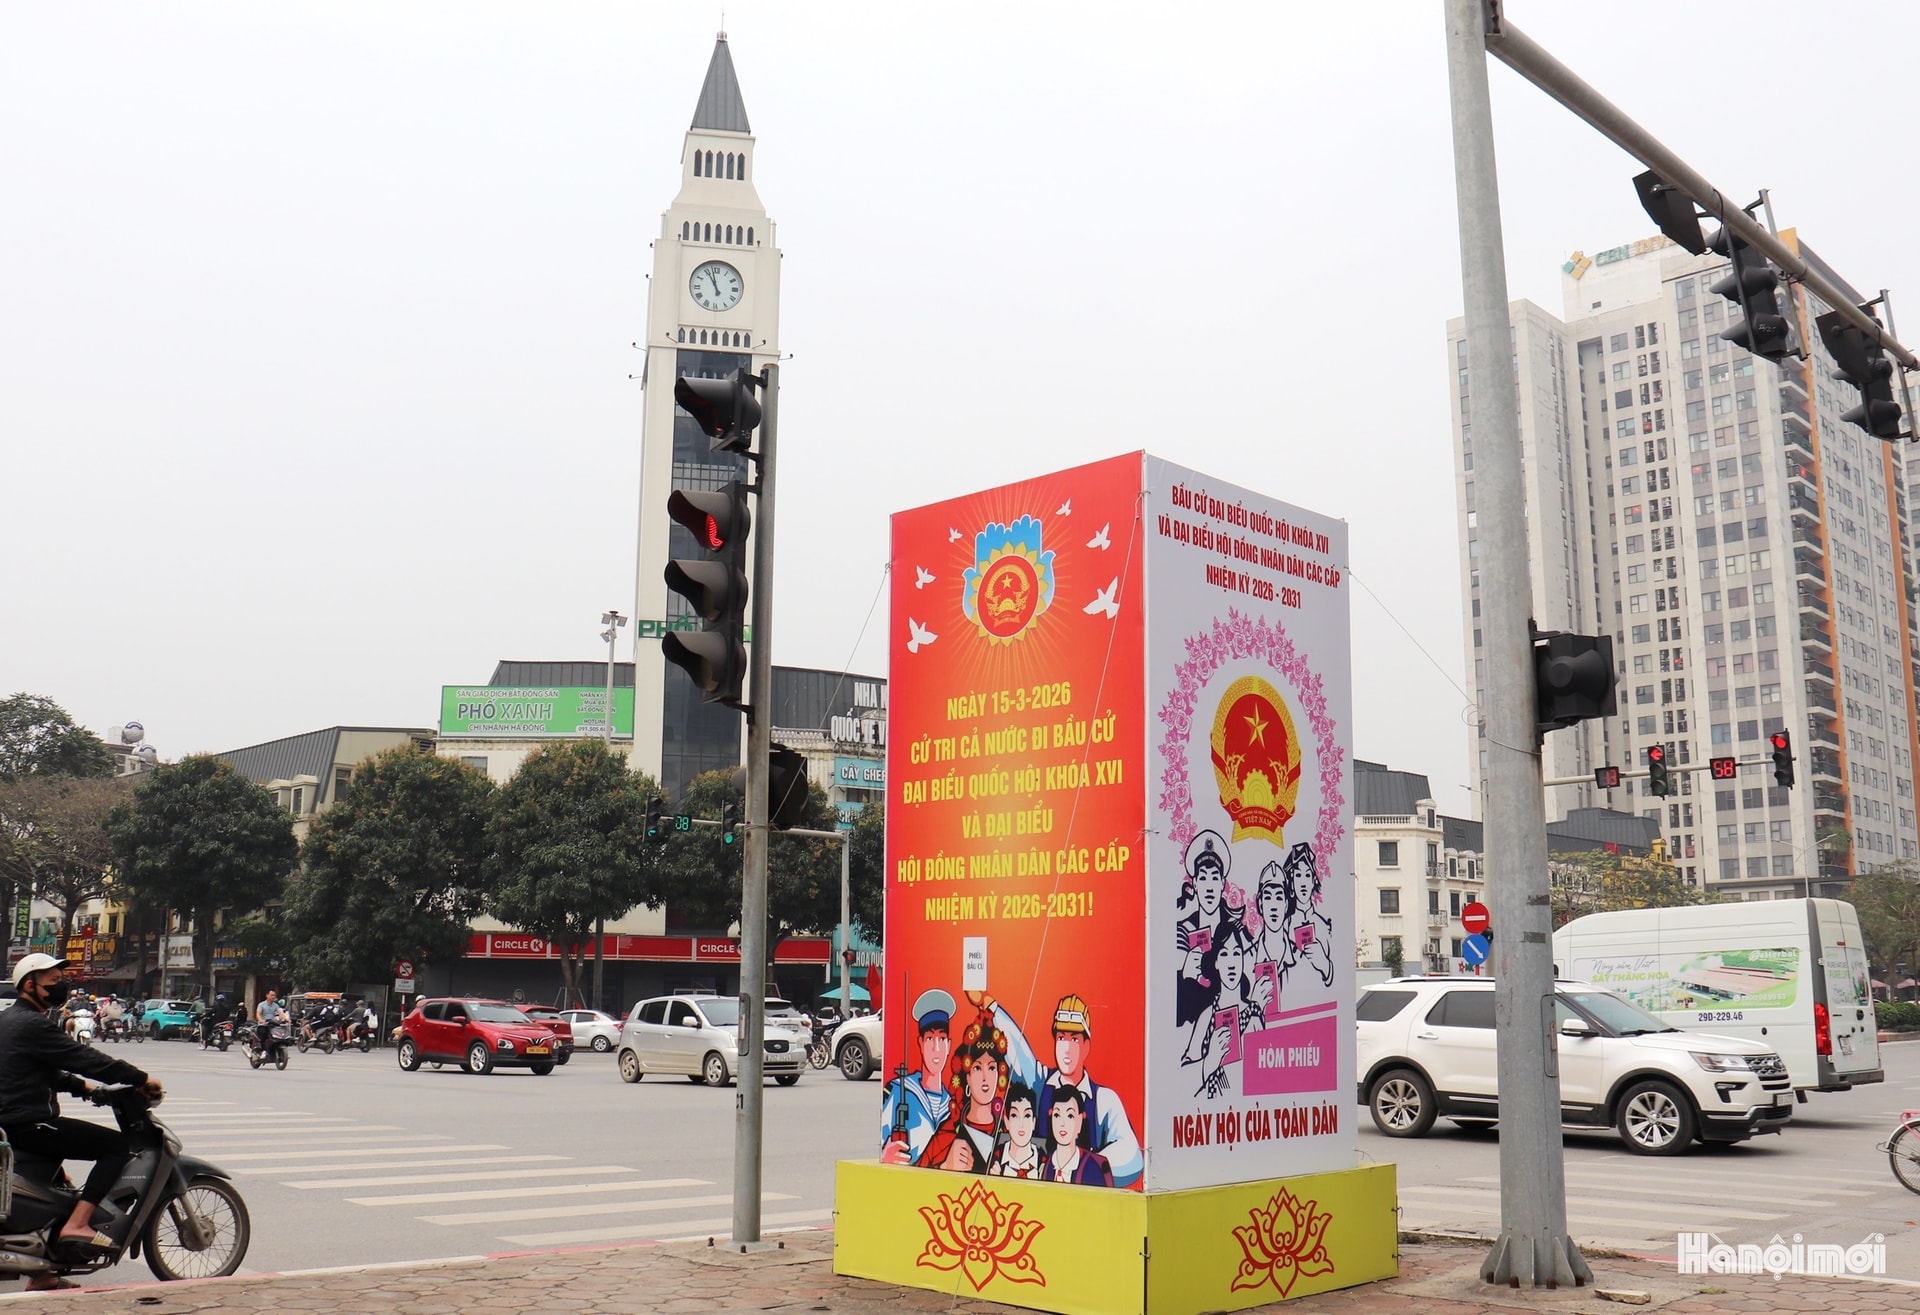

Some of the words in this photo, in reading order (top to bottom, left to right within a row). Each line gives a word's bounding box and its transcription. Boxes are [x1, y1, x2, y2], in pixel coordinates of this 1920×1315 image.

[1172, 482, 1192, 510] BẦU
[1194, 488, 1208, 515] CỬ
[1209, 498, 1225, 523] ĐẠI
[1227, 500, 1248, 528] BIỂU
[1250, 510, 1273, 536] QUỐC
[1275, 518, 1290, 545] HỘI
[1291, 526, 1314, 550] KHÓA
[1316, 533, 1329, 555] XVI
[1158, 513, 1171, 538] VÀ
[1173, 520, 1190, 546] ĐẠI
[1192, 521, 1214, 550] BIỂU
[1216, 532, 1231, 559] HỘI
[1234, 535, 1258, 564] ĐỒNG
[1261, 547, 1285, 572] NHÂN
[1287, 554, 1304, 578] DÂN
[1306, 560, 1323, 584] CÁC
[1324, 563, 1341, 588] CẤP
[1206, 563, 1236, 592] NHIỆM
[1238, 571, 1250, 595] KỲ
[1252, 578, 1274, 602] 2026
[1281, 586, 1302, 609] 2031
[458, 698, 496, 719] PHỐ
[501, 703, 552, 720] XANH
[947, 690, 987, 721] NGÀY
[992, 681, 1071, 714] 15-3-2026
[910, 733, 931, 765] CỬ
[934, 738, 956, 762] TRI
[960, 727, 980, 759] CẢ
[985, 724, 1027, 756] NƯỚC
[1032, 726, 1048, 751] ĐI
[1053, 713, 1086, 749] BẦU
[1091, 709, 1117, 744] CỬ
[903, 780, 927, 809] ĐẠI
[931, 767, 964, 802] BIỂU
[969, 764, 1009, 800] QUỐC
[1014, 764, 1041, 798] HỘI
[1046, 759, 1090, 791] KHÓA
[1095, 759, 1123, 786] XVI
[1713, 760, 1734, 778] 58
[962, 810, 982, 839] VÀ
[985, 812, 1011, 842] ĐẠI
[1016, 799, 1053, 834] BIỂU
[897, 854, 921, 887] HỘI
[925, 850, 965, 882] ĐỒNG
[969, 849, 1013, 879] NHÂN
[1017, 846, 1051, 876] DÂN
[1056, 844, 1089, 875] CÁC
[1094, 837, 1130, 873] CẤP
[925, 892, 974, 926] NHIỆM
[978, 890, 998, 919] KỲ
[494, 940, 529, 950] CIRCLE
[700, 944, 735, 953] CIRCLE
[1698, 1011, 1744, 1022] 29D-229.46
[1258, 1043, 1285, 1069] HÒM
[1288, 1040, 1321, 1068] PHIẾU
[1173, 1107, 1213, 1149] NGÀY
[1216, 1105, 1241, 1151] HỘI
[1245, 1101, 1271, 1142] CỦA
[1274, 1101, 1309, 1139] TOÀN
[1312, 1099, 1338, 1136] DÂN
